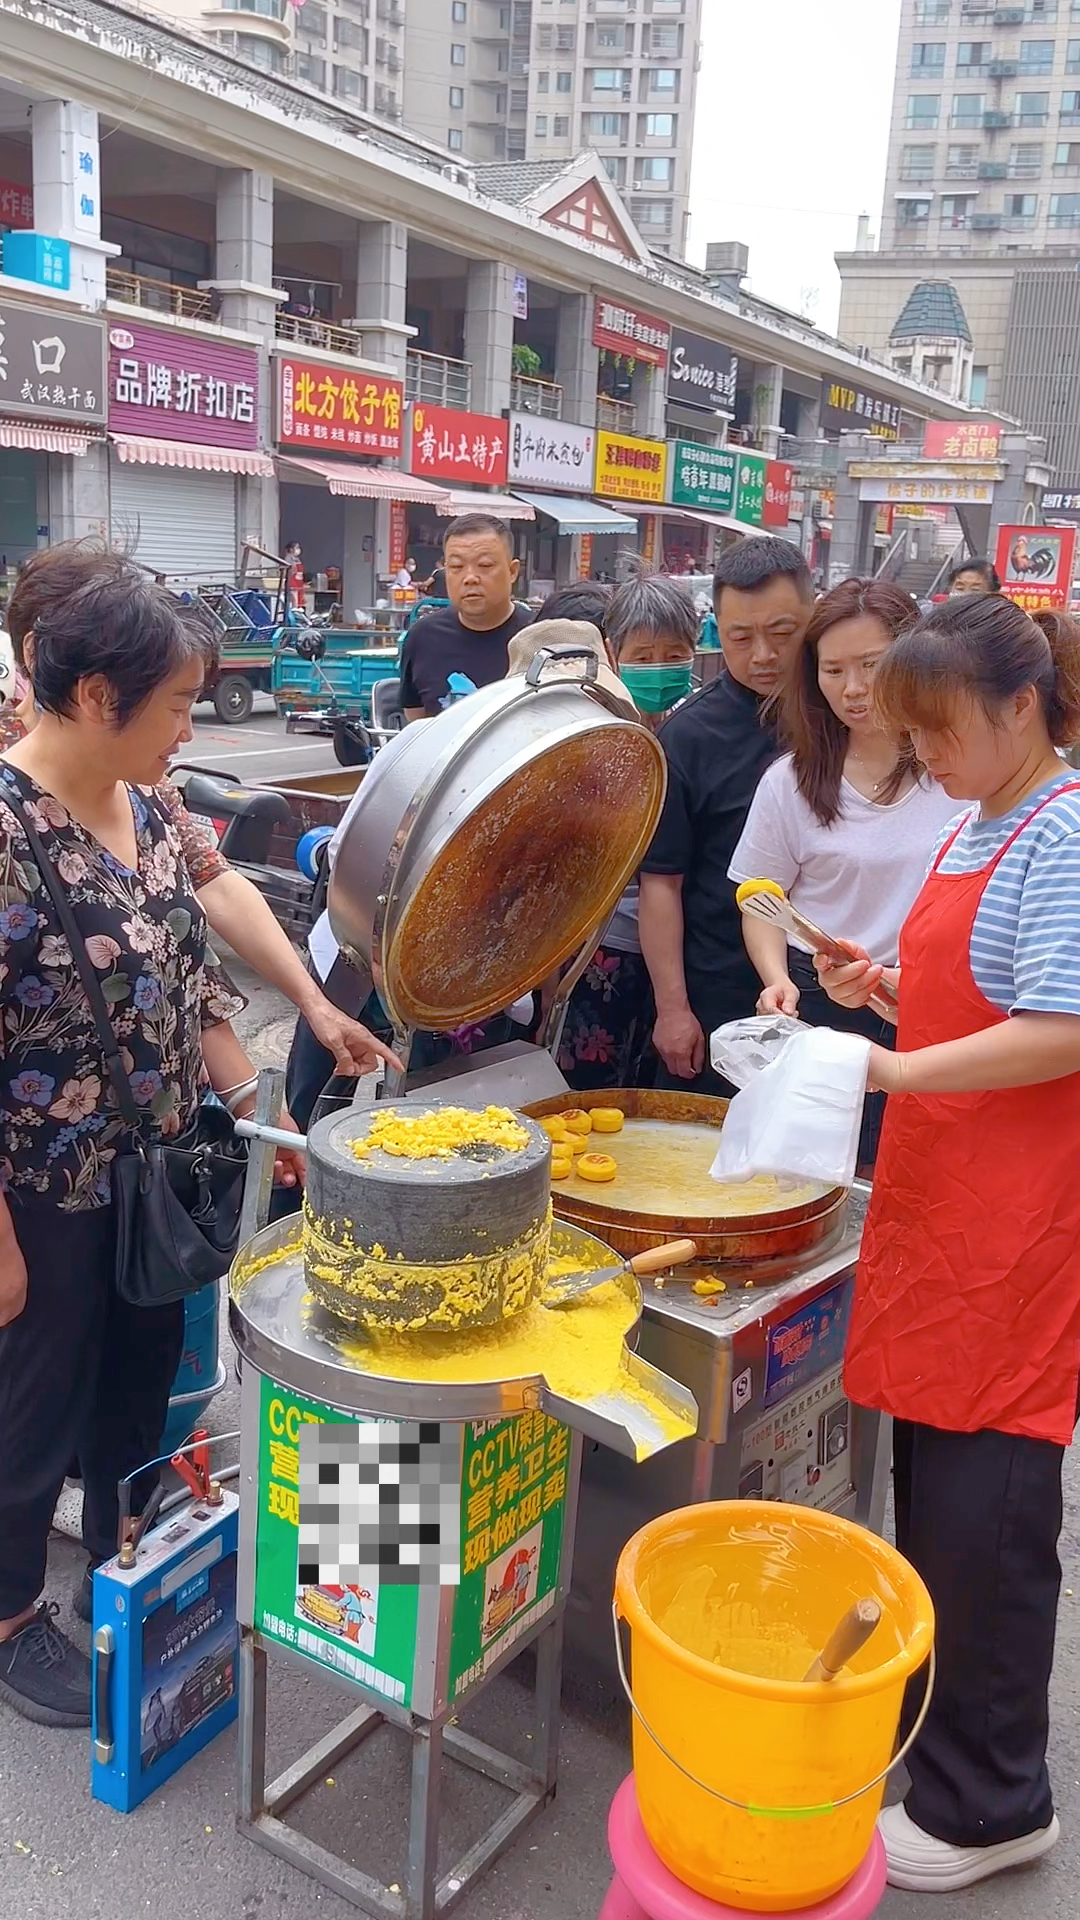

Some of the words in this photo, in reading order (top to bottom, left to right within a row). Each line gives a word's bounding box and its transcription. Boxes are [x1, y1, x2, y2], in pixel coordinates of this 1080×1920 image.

[79, 152, 95, 217] 瑜伽
[20, 378, 96, 410] 武汉热干面
[116, 358, 255, 423] 品牌折扣店
[294, 371, 400, 430] 北方饺子馆
[828, 383, 855, 412] MVP
[416, 424, 504, 474] 黄山土特产
[943, 436, 998, 458] 老卤鸭
[957, 425, 989, 436] 水西门
[467, 1428, 569, 1532] 营养卫生
[463, 1466, 566, 1576] 现做现卖
